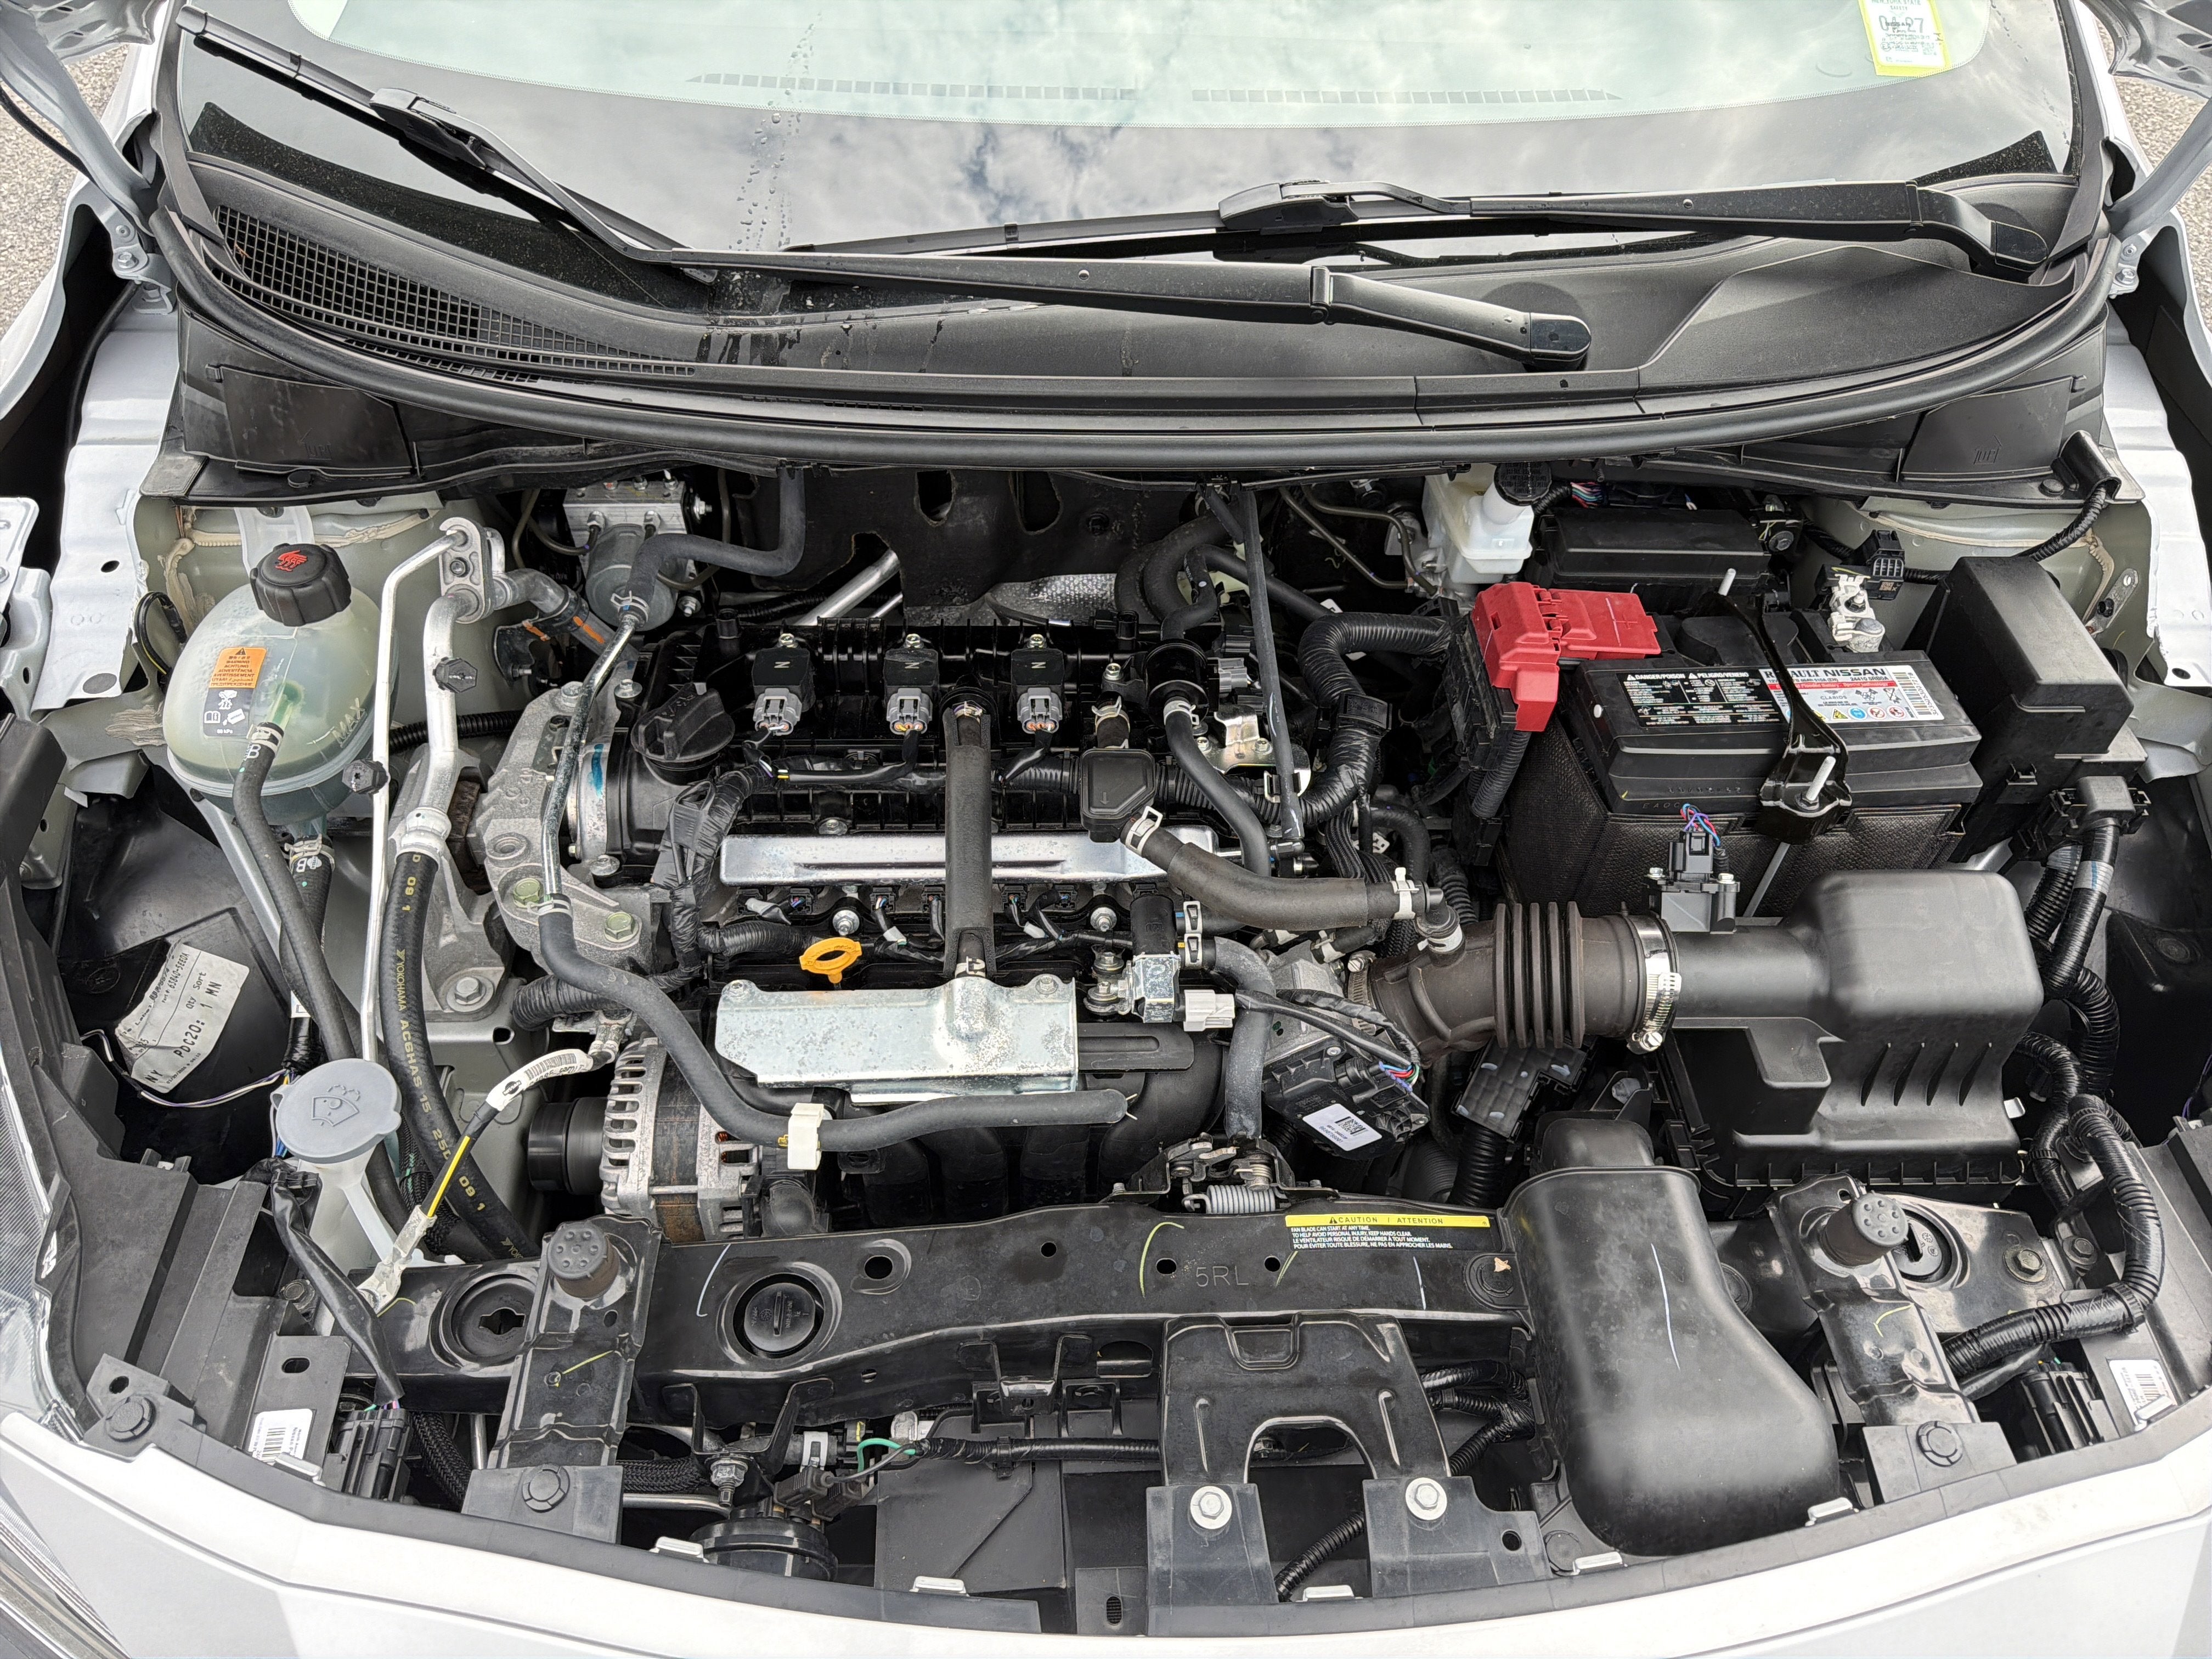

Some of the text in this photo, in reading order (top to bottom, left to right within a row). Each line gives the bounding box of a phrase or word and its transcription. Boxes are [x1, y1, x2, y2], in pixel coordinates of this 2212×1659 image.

[1823, 668, 1886, 676] NISSAN
[331, 697, 368, 748] MAX
[249, 743, 261, 759] B
[185, 971, 207, 1009] Qty Sort
[205, 981, 222, 997] MN
[396, 961, 407, 1012] YOKOHAMA
[400, 1019, 422, 1088] AC6HAS
[419, 1093, 432, 1114] 15
[1195, 1265, 1249, 1287] 5RL
